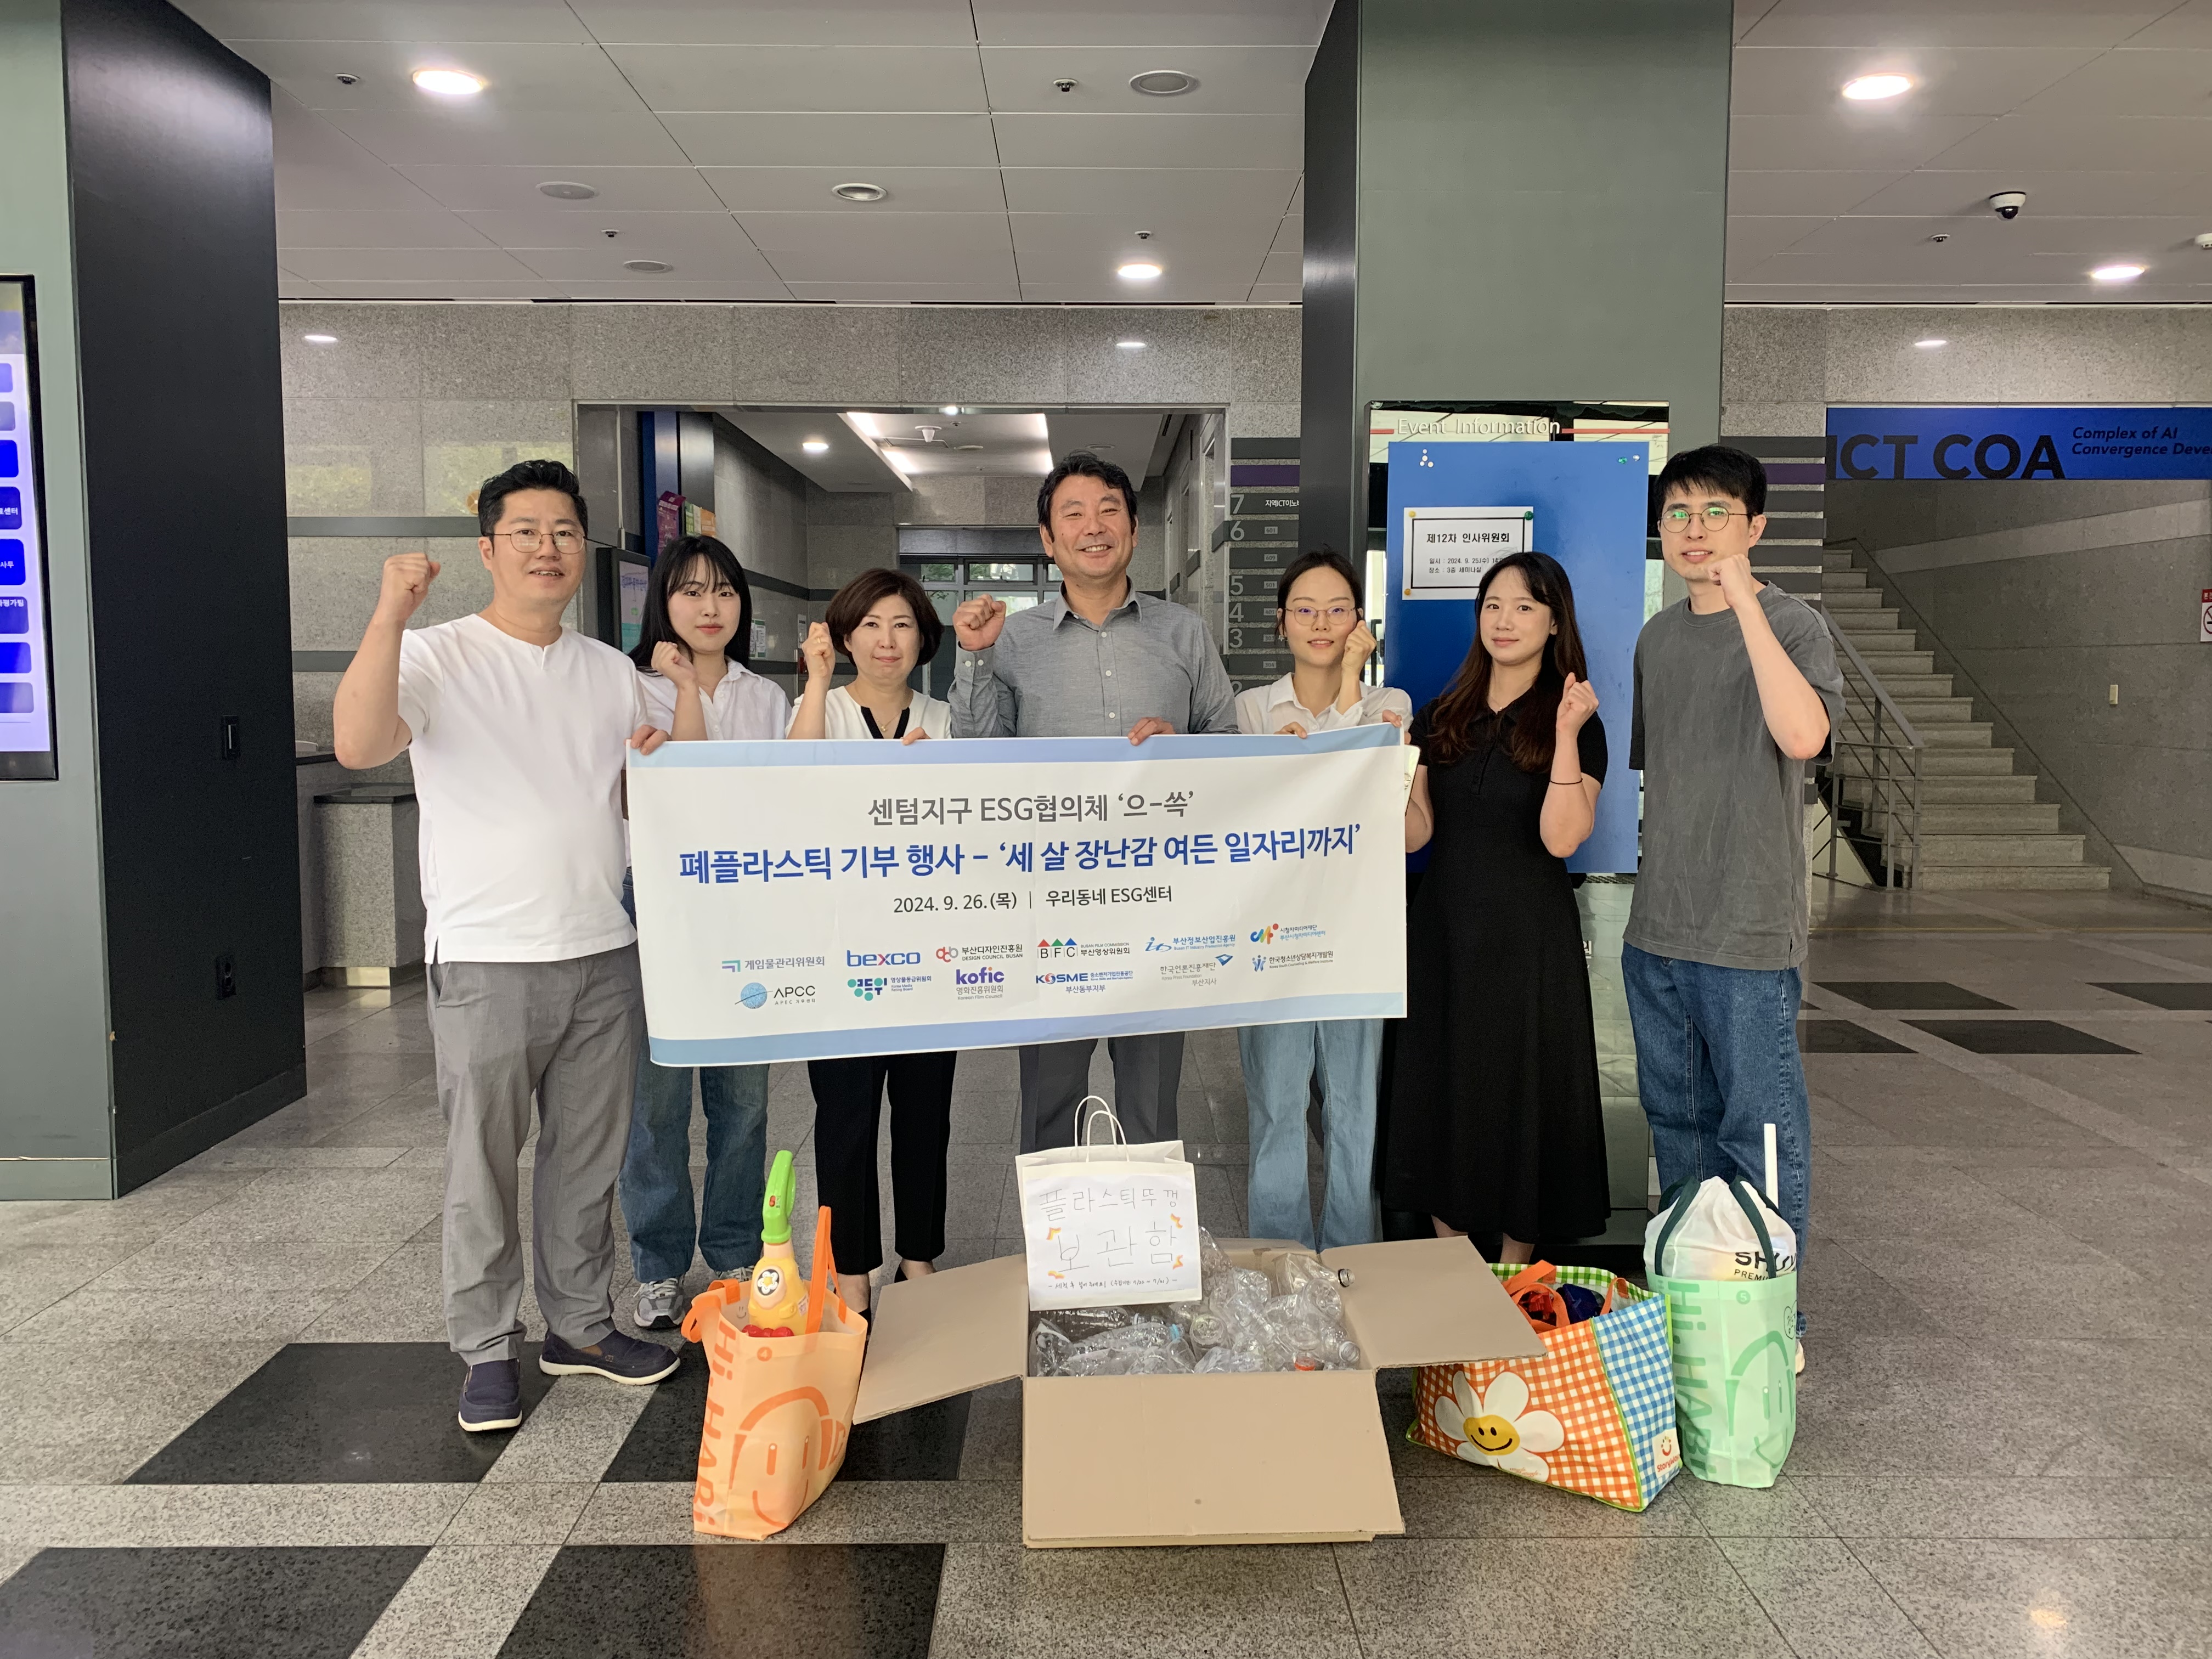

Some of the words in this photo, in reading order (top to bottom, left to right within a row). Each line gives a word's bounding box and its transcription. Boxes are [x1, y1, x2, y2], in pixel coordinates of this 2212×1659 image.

[1397, 417, 1447, 436] Event
[1455, 417, 1561, 435] Information
[2072, 426, 2137, 442] Complex
[2141, 426, 2159, 439] of
[2160, 427, 2179, 439] AI
[1826, 433, 1918, 479] ICT
[1932, 433, 2067, 479] COA
[2072, 442, 2168, 458] Convergence
[2172, 442, 2212, 455] Deve
[1231, 494, 1245, 514] 7
[1230, 521, 1245, 541] 6
[1426, 533, 1457, 544] 제12차
[1462, 532, 1510, 544] 인사위원회
[1229, 575, 1244, 595] 5
[1229, 602, 1244, 622] 4
[1229, 628, 1243, 648] 3
[867, 797, 973, 826] 센텀지구
[980, 794, 1108, 823] ESG협의체
[679, 847, 832, 884] 폐플라스틱
[840, 845, 900, 879] 기부
[905, 843, 965, 877] 행사
[1039, 839, 1070, 871] 살
[1074, 836, 1158, 870] 장난감
[1163, 832, 1219, 866] 여든
[893, 896, 939, 914] 2024.
[1045, 888, 1107, 908] 우리동네
[1110, 884, 1173, 904] ESG센터
[1279, 924, 1318, 934] 시청자미디어재단
[1172, 934, 1236, 945] 부산정보산업진흥원
[961, 944, 1023, 955] 부산디자인진흥원
[1080, 947, 1130, 957] 부산영상위원회
[1268, 950, 1334, 964] 한국청소년상담복지개발원
[744, 956, 826, 970] 게임물관리위원회
[846, 949, 921, 967] bexco
[956, 966, 1005, 985] kofic
[1160, 962, 1217, 975] 한국언론진흥재단
[890, 975, 932, 984] 영상물등급위원회
[1191, 977, 1217, 987] 부산지사
[773, 985, 816, 998] APCC
[956, 984, 1003, 996] 영화진흥위원회
[1065, 984, 1106, 994] 부산동부지부
[1058, 1221, 1178, 1273] 보관함
